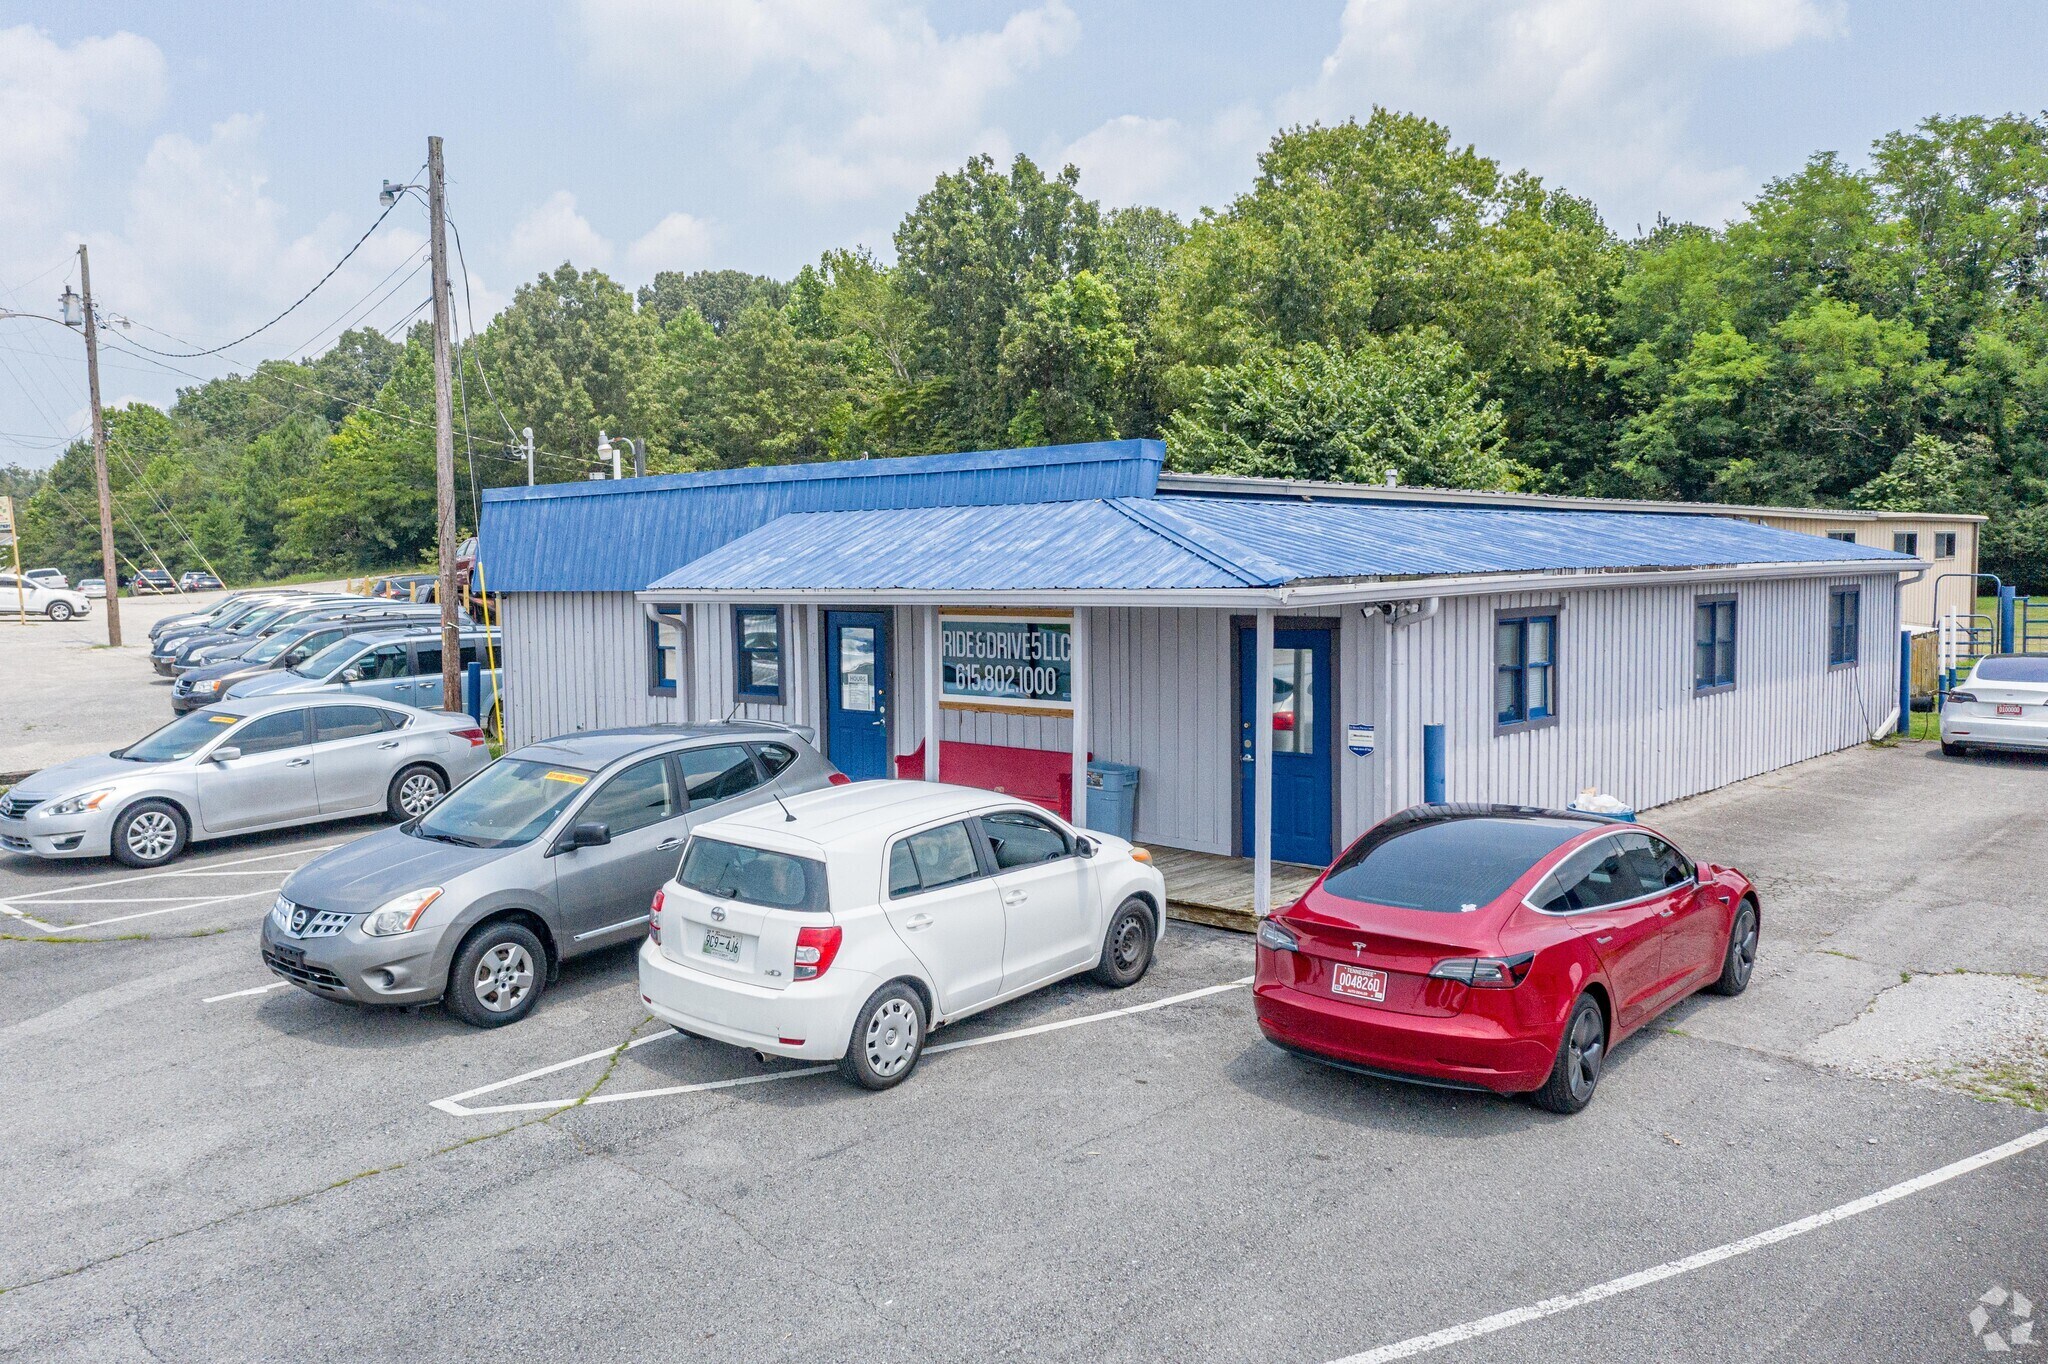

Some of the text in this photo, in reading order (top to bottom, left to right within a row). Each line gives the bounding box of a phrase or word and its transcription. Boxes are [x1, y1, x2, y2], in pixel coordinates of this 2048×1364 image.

[955, 663, 1057, 696] 615.802.1000
[1340, 972, 1380, 992] 004826D
[1347, 967, 1374, 978] TENNESSEE
